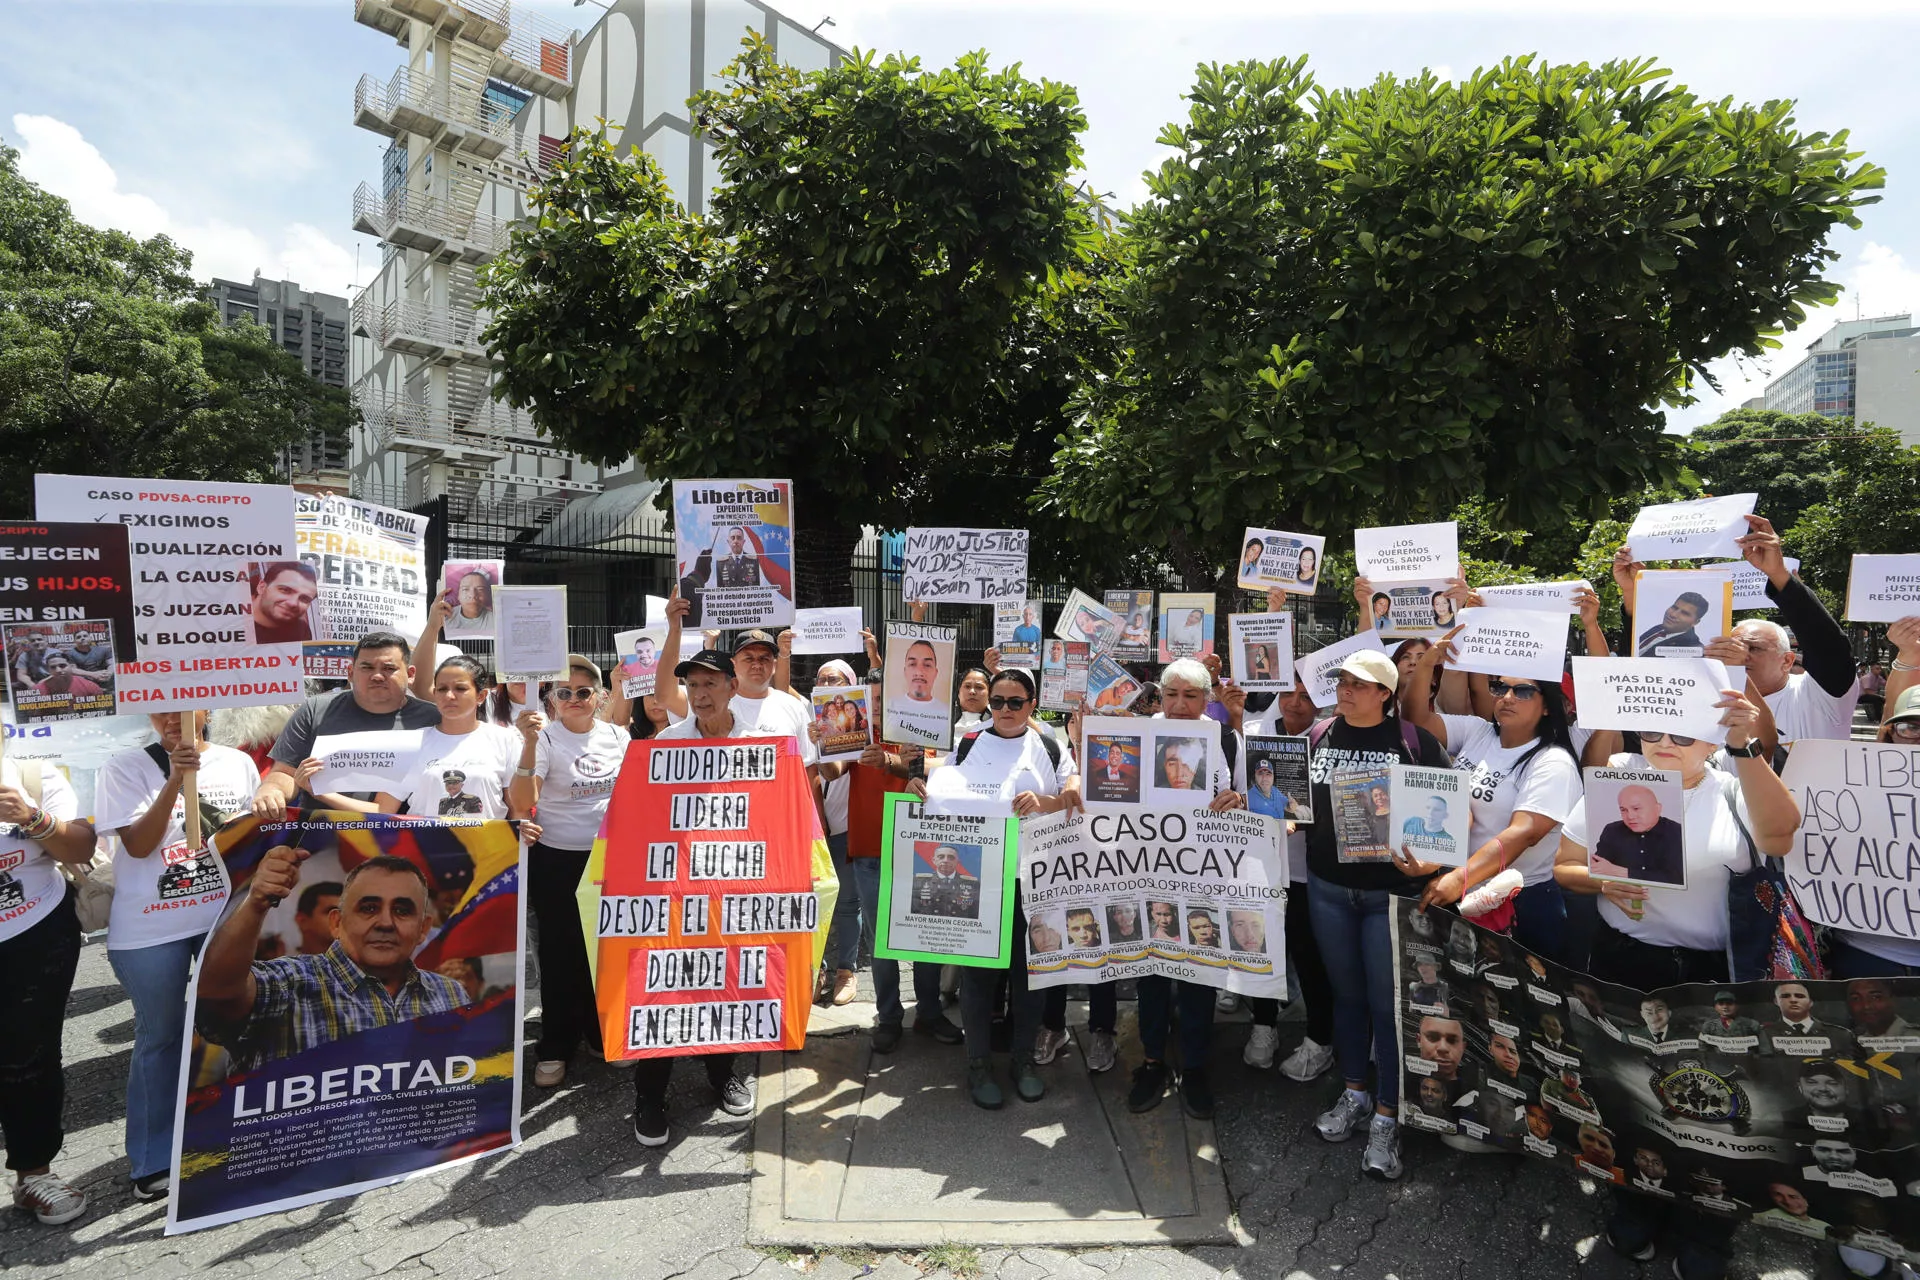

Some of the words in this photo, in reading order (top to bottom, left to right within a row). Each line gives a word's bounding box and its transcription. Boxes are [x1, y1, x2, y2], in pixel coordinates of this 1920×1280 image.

[87, 490, 134, 501] CASO
[138, 492, 252, 505] PDVSA-CRIPTO
[692, 489, 780, 504] Libertad
[716, 504, 754, 513] EXPEDIENTE
[119, 514, 230, 528] EXIGIMOS
[322, 516, 340, 526] DE
[352, 506, 371, 522] DE
[375, 511, 417, 534] ABRIL
[1393, 540, 1414, 548] ¡LOS
[1266, 546, 1300, 558] LIBERTAD
[1378, 547, 1429, 557] QUEREMOS
[1400, 554, 1432, 564] SANOS
[1262, 567, 1296, 580] MARTINEZ
[1280, 562, 1300, 572] KEYLA
[1386, 564, 1422, 572] LIBRES!
[141, 571, 169, 583] LA
[177, 570, 250, 583] CAUSA
[37, 577, 121, 592] HIJOS,
[746, 592, 772, 600] proceso
[1526, 588, 1544, 597] SER
[743, 600, 773, 608] expediente
[997, 601, 1020, 610] FERNEY
[1393, 596, 1430, 606] LIBERTAD
[42, 606, 86, 620] SIN
[164, 604, 252, 617] JUZGAN
[718, 608, 752, 617] respuesta
[1392, 610, 1406, 618] NAIS
[1408, 610, 1412, 618] Y
[1414, 610, 1435, 618] KEYLA
[717, 617, 730, 625] Sin
[731, 616, 761, 624] Justicia
[1396, 618, 1432, 626] MARTINEZ
[157, 630, 246, 645] BLOQUE
[1478, 627, 1530, 639] MINISTRO
[1463, 634, 1502, 646] GARCÍA
[1504, 639, 1544, 650] ZERPA:
[1467, 645, 1484, 654] ¡DE
[1488, 646, 1500, 655] LA
[1504, 648, 1537, 659] CARA!
[180, 656, 281, 672] LIBERTAD
[287, 654, 301, 667] Y
[1645, 676, 1664, 684] DE
[1668, 678, 1696, 688] 400
[172, 680, 298, 700] INDIVIDUAL!
[1616, 686, 1684, 696] FAMILIAS
[1624, 696, 1676, 706] EXIGEN
[1617, 706, 1684, 717] JUSTICIA!
[900, 720, 940, 741] Libertad
[330, 752, 348, 762] ¡SIN
[350, 752, 396, 760] JUSTICIA
[1315, 748, 1352, 760] LIBEREN
[1352, 750, 1360, 760] A
[1362, 751, 1400, 764] TODOS
[349, 760, 368, 768] HAY
[371, 760, 394, 768] PAZ!
[652, 748, 774, 782] CIUDADANO
[1312, 758, 1336, 770] LOS
[1404, 771, 1438, 781] LIBERTAD
[1438, 774, 1458, 784] PARA
[1594, 770, 1636, 782] CARLOS
[1638, 773, 1668, 782] VIDAL
[1404, 779, 1434, 790] RAMON
[1436, 782, 1458, 792] SOTO
[672, 795, 746, 828] LIDERA
[1192, 808, 1264, 828] GUAICAIPURO
[260, 822, 282, 832] DIOS
[285, 821, 299, 830] ES
[301, 821, 333, 831] QUIEN
[336, 820, 382, 830] ESCRIBE
[384, 820, 432, 829] NUESTRA
[435, 818, 483, 828] HISTORIA
[920, 822, 980, 834] EXPEDIENTE
[1090, 813, 1187, 842] CASO
[1196, 822, 1230, 833] RAMO
[1232, 824, 1265, 838] VERDE
[900, 831, 999, 846] CJPM-TM1C-421-2025
[1042, 842, 1053, 851] 30
[1054, 833, 1080, 847] AÑOS
[1196, 833, 1248, 846] TUCUYITO
[1404, 833, 1415, 842] QUE
[650, 845, 676, 878] LA
[691, 844, 764, 878] LUCHA
[1804, 833, 1842, 876] EX
[1030, 846, 1246, 890] PARAMACAY
[177, 880, 191, 888] 3
[143, 900, 198, 914] ¿HASTA
[600, 898, 666, 934] DESDE
[684, 898, 705, 933] EL
[724, 894, 816, 932] TERRENO
[928, 917, 952, 926] MARVIN
[952, 919, 982, 928] CEQUERA
[1228, 956, 1272, 964] TORTURADO
[648, 950, 724, 989] DONDE
[742, 949, 764, 985] TE
[1100, 961, 1196, 980] #QueSeanTodos
[631, 1002, 778, 1046] ENCUENTRES
[1776, 1038, 1802, 1046] Miguel
[232, 1055, 477, 1119] LIBERTAD
[232, 1118, 259, 1128] PARA
[262, 1112, 293, 1122] TODOS
[294, 1108, 312, 1116] LOS
[314, 1100, 348, 1112] PRESOS
[350, 1092, 394, 1106] POLÍTICOS,
[436, 1084, 476, 1094] MILITARES
[228, 1142, 262, 1152] Alcalde
[440, 1106, 476, 1116] encuentra
[230, 1131, 270, 1144] Exigimos
[287, 1120, 320, 1132] libertad
[382, 1105, 418, 1116] Fernando
[228, 1148, 268, 1162] detenido
[270, 1136, 326, 1154] injustamente
[328, 1132, 352, 1142] desde
[254, 1164, 279, 1174] delito
[419, 1131, 456, 1142] Venezuela
[1716, 1141, 1728, 1150] A
[1730, 1144, 1776, 1152] TODOS
